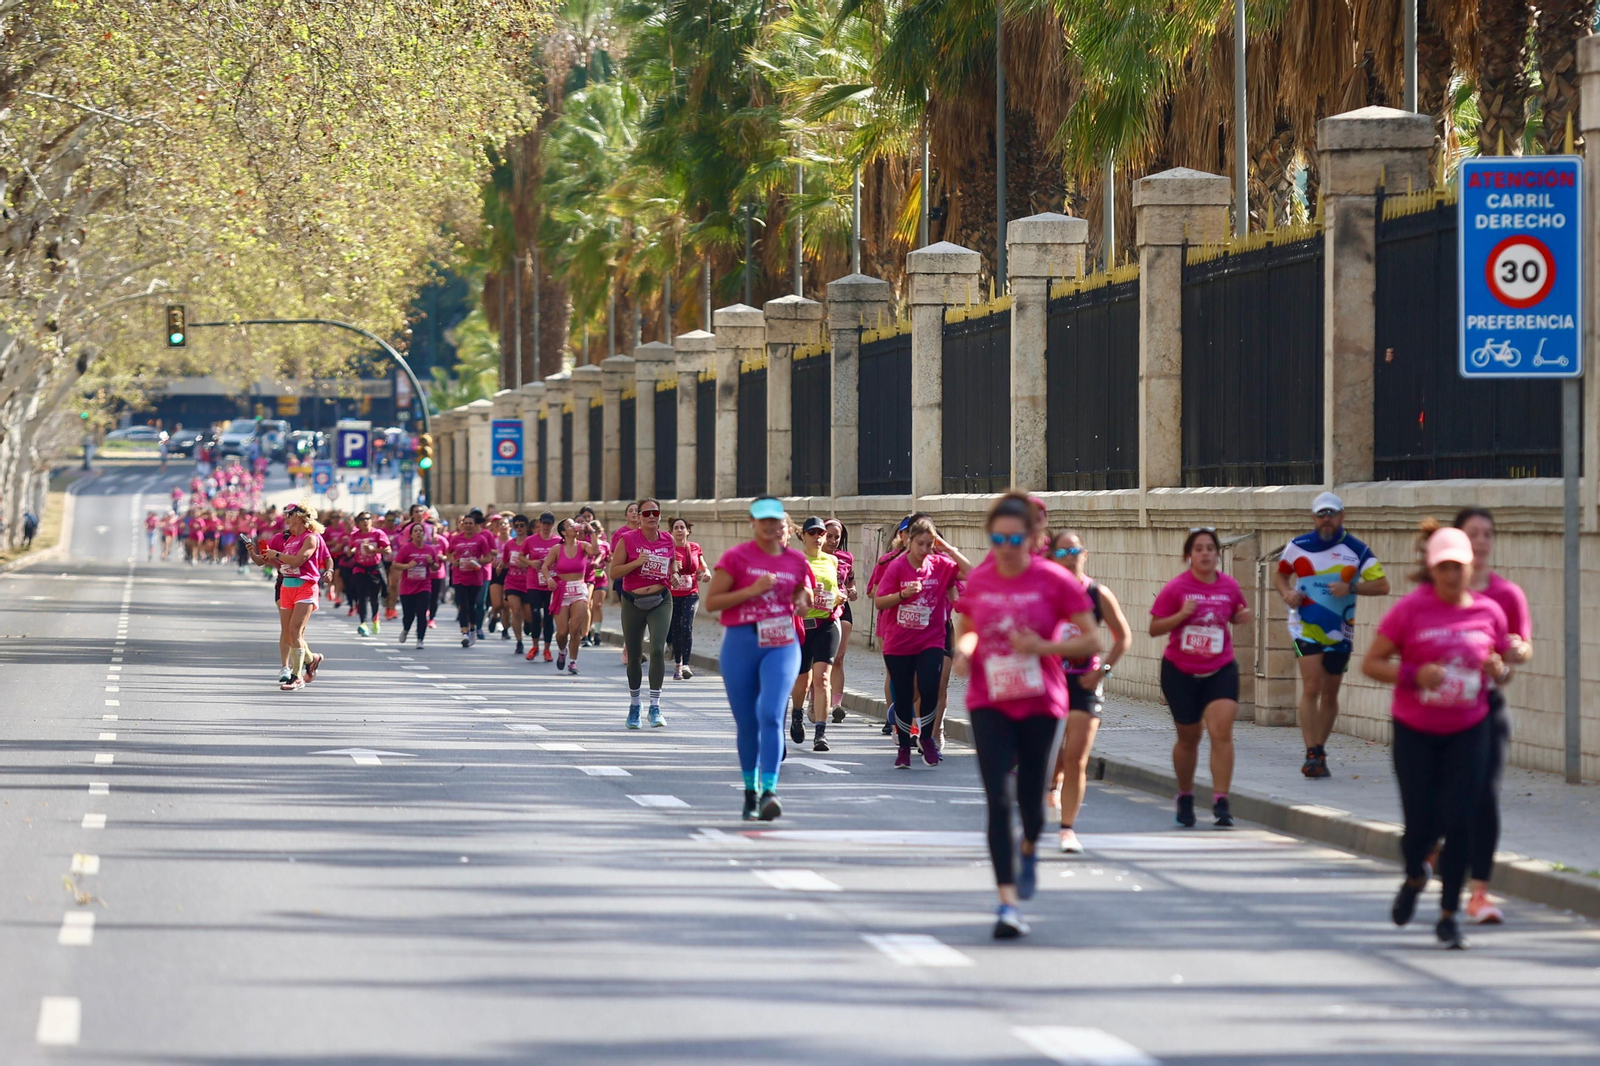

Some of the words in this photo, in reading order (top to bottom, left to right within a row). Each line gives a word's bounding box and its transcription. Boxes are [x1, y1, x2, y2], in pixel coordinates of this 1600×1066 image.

[1468, 168, 1575, 188] ATENCIÓN
[1486, 193, 1554, 209] CARRIL
[1475, 213, 1566, 229] DERECHO
[1501, 259, 1541, 283] 30
[1467, 314, 1575, 330] PREFERENCIA
[344, 432, 365, 458] P
[645, 561, 662, 570] 3597
[900, 611, 920, 621] 5005
[1190, 636, 1208, 647] 987
